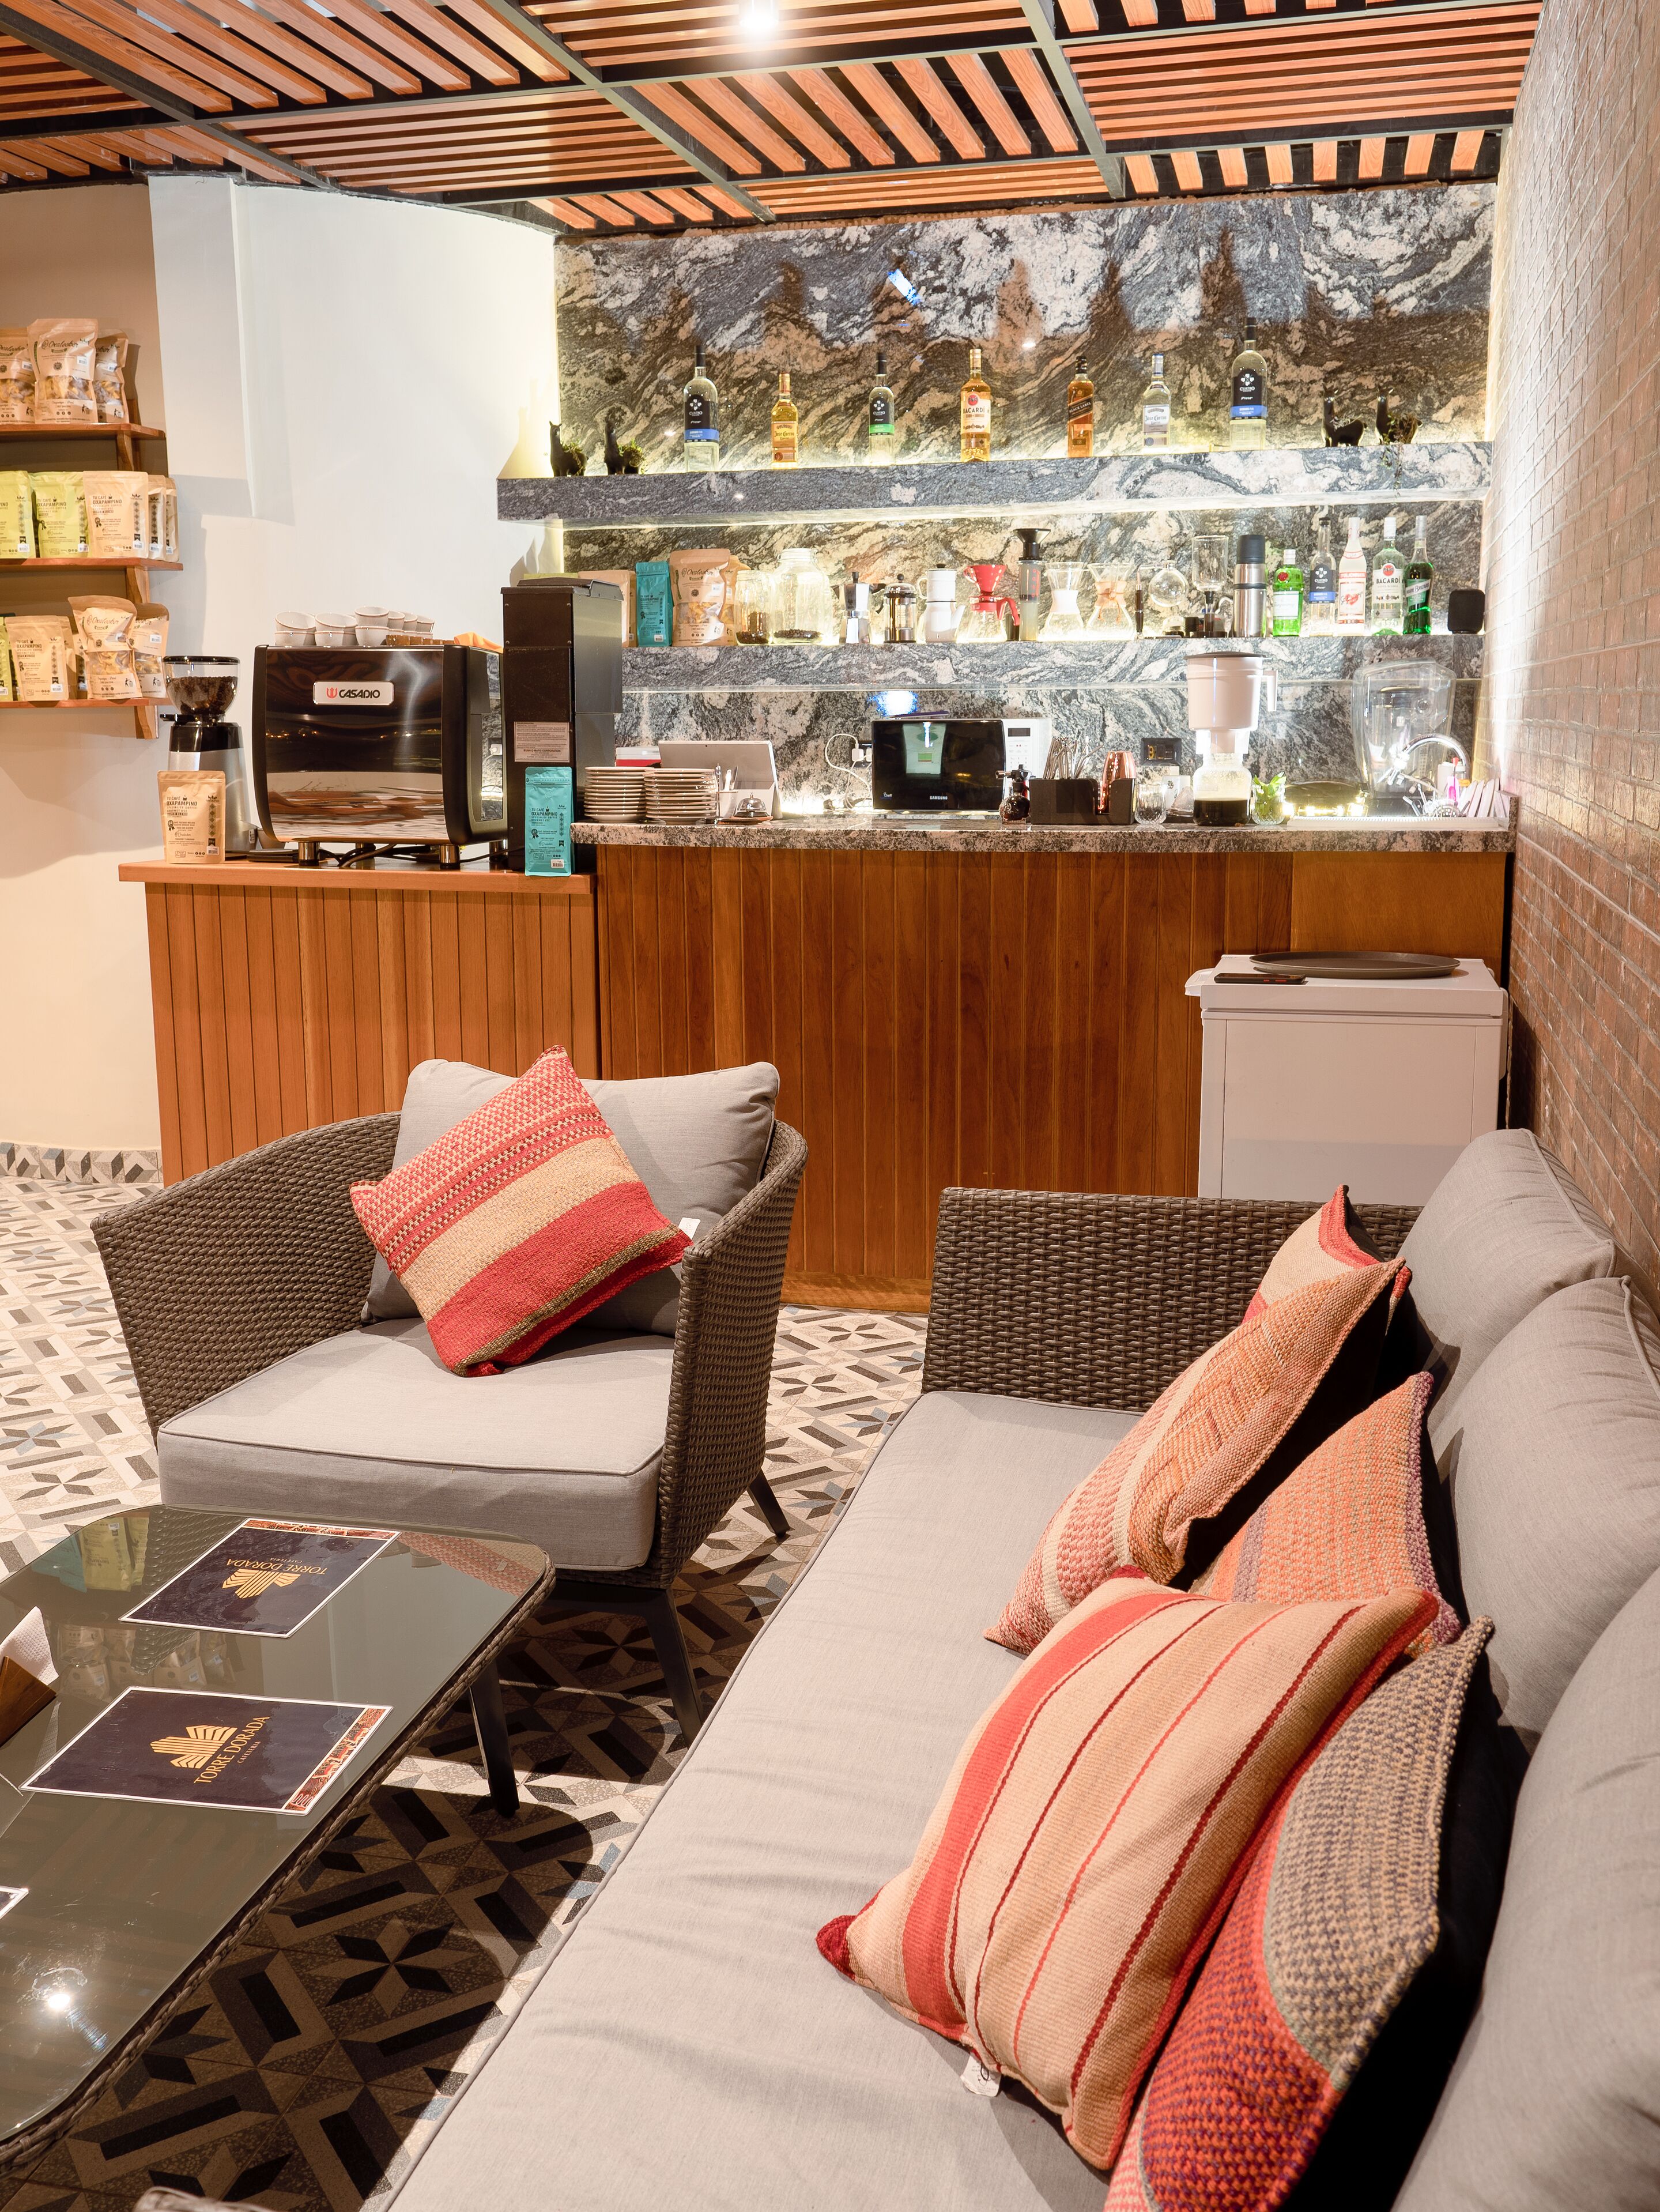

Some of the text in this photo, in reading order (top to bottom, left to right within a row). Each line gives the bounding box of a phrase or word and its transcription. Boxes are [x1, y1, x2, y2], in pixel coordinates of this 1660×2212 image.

[339, 689, 380, 698] CASADIO
[226, 1558, 329, 1575] TORRE DORADA
[194, 1717, 270, 1784] TORRE DORADA
